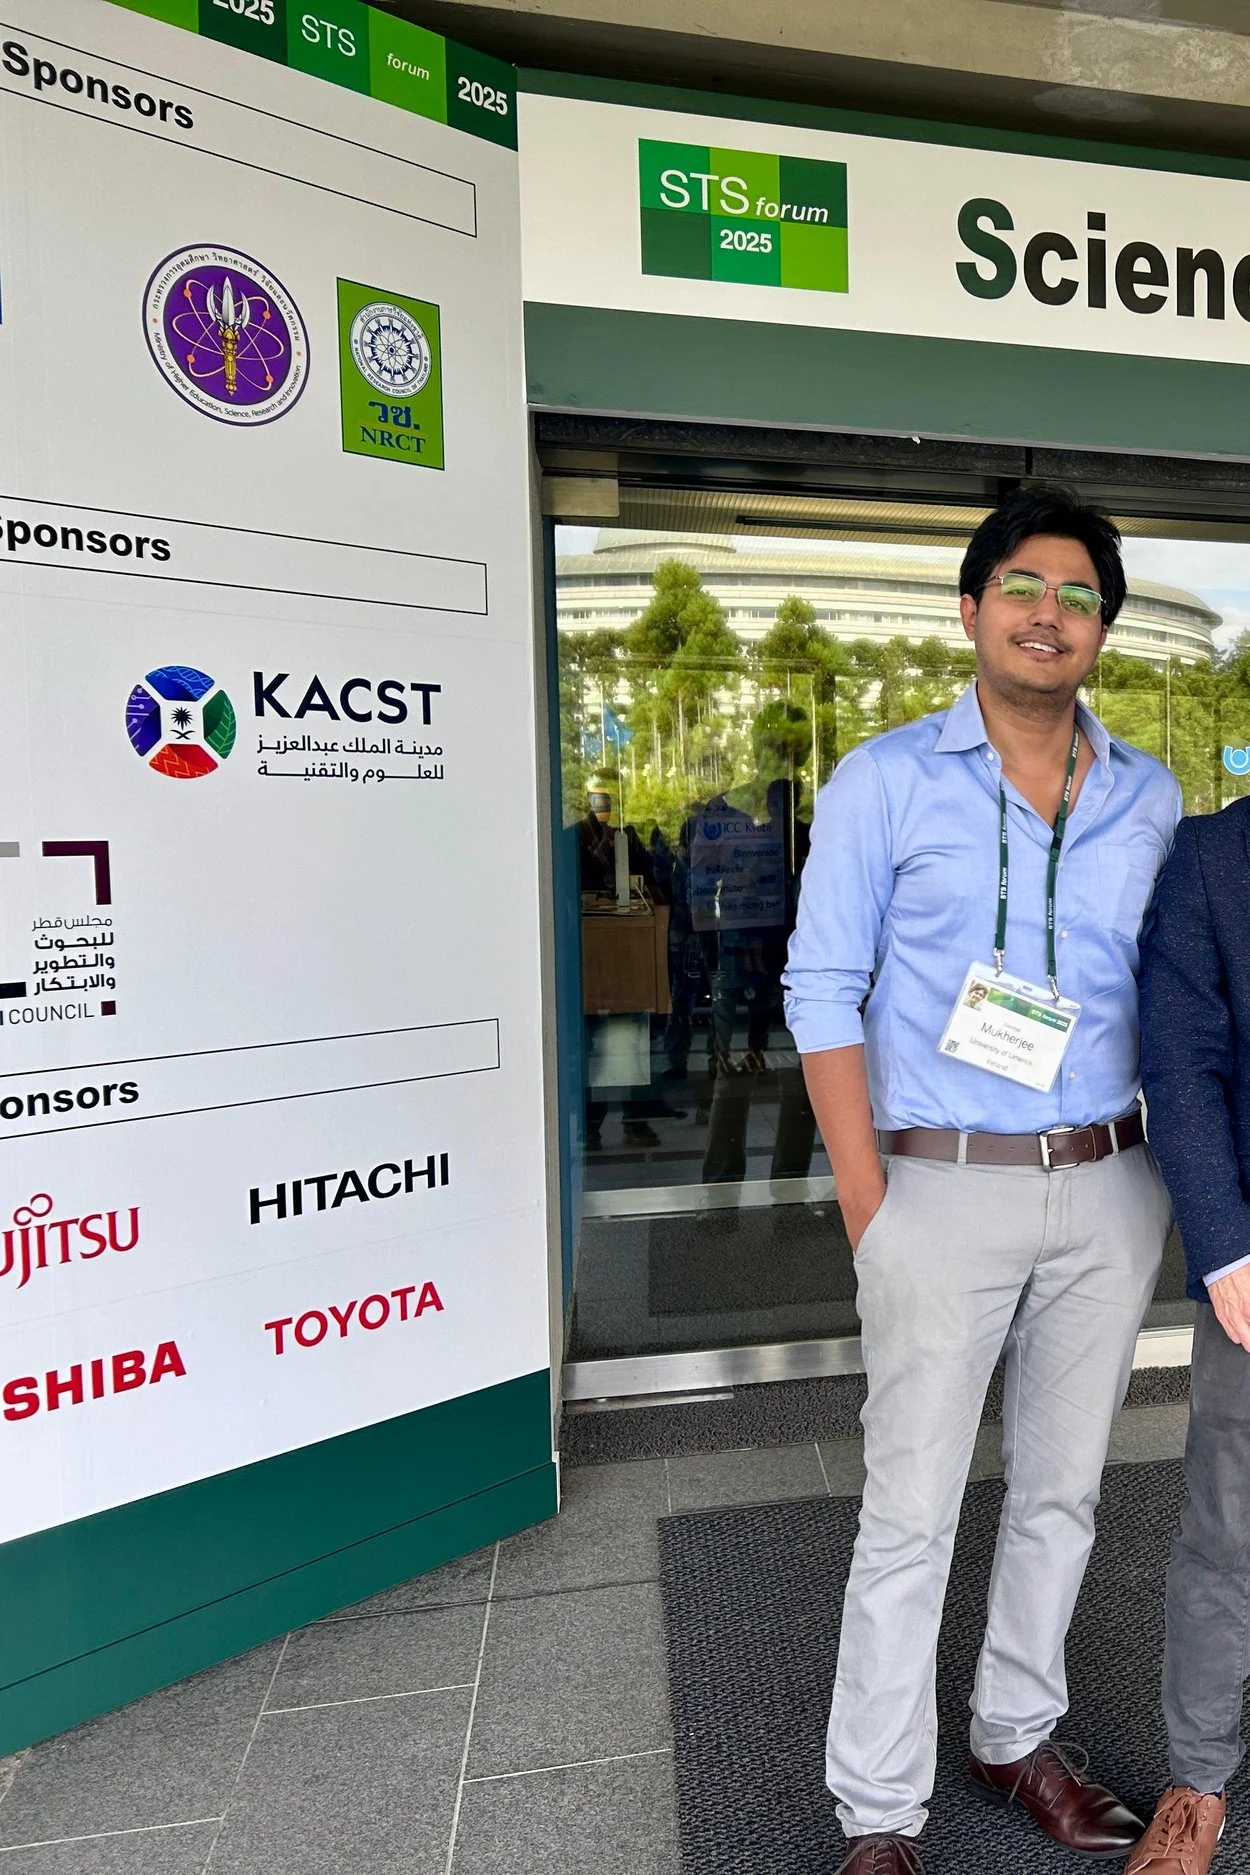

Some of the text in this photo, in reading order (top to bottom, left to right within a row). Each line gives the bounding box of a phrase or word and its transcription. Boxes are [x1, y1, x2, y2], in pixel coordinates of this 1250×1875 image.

[301, 14, 508, 115] STS forum 2025
[1, 40, 194, 129] Sponsors
[659, 169, 830, 225] STS forum
[719, 228, 773, 254] 2025
[154, 332, 167, 361] Ministry
[165, 360, 174, 370] of
[169, 366, 189, 391] Higher
[285, 365, 301, 397] Innovation
[252, 403, 277, 417] Research
[276, 395, 287, 407] and
[369, 401, 420, 430] วช.
[360, 426, 426, 453] NRCT
[0, 515, 171, 561] ponsors
[253, 671, 441, 725] KACST
[342, 737, 391, 754] الملك
[32, 915, 113, 932] مجلس قطر
[34, 932, 114, 951] للبحوث
[33, 953, 115, 975] والتطوير
[34, 974, 116, 996] والابتكار
[8, 1003, 95, 1025] COUNCIL
[980, 1022, 1034, 1051] Mukherjee
[249, 1152, 450, 1225] HITACHI
[265, 1281, 444, 1355] TOYOTA
[2, 1341, 187, 1422] SHIBA
